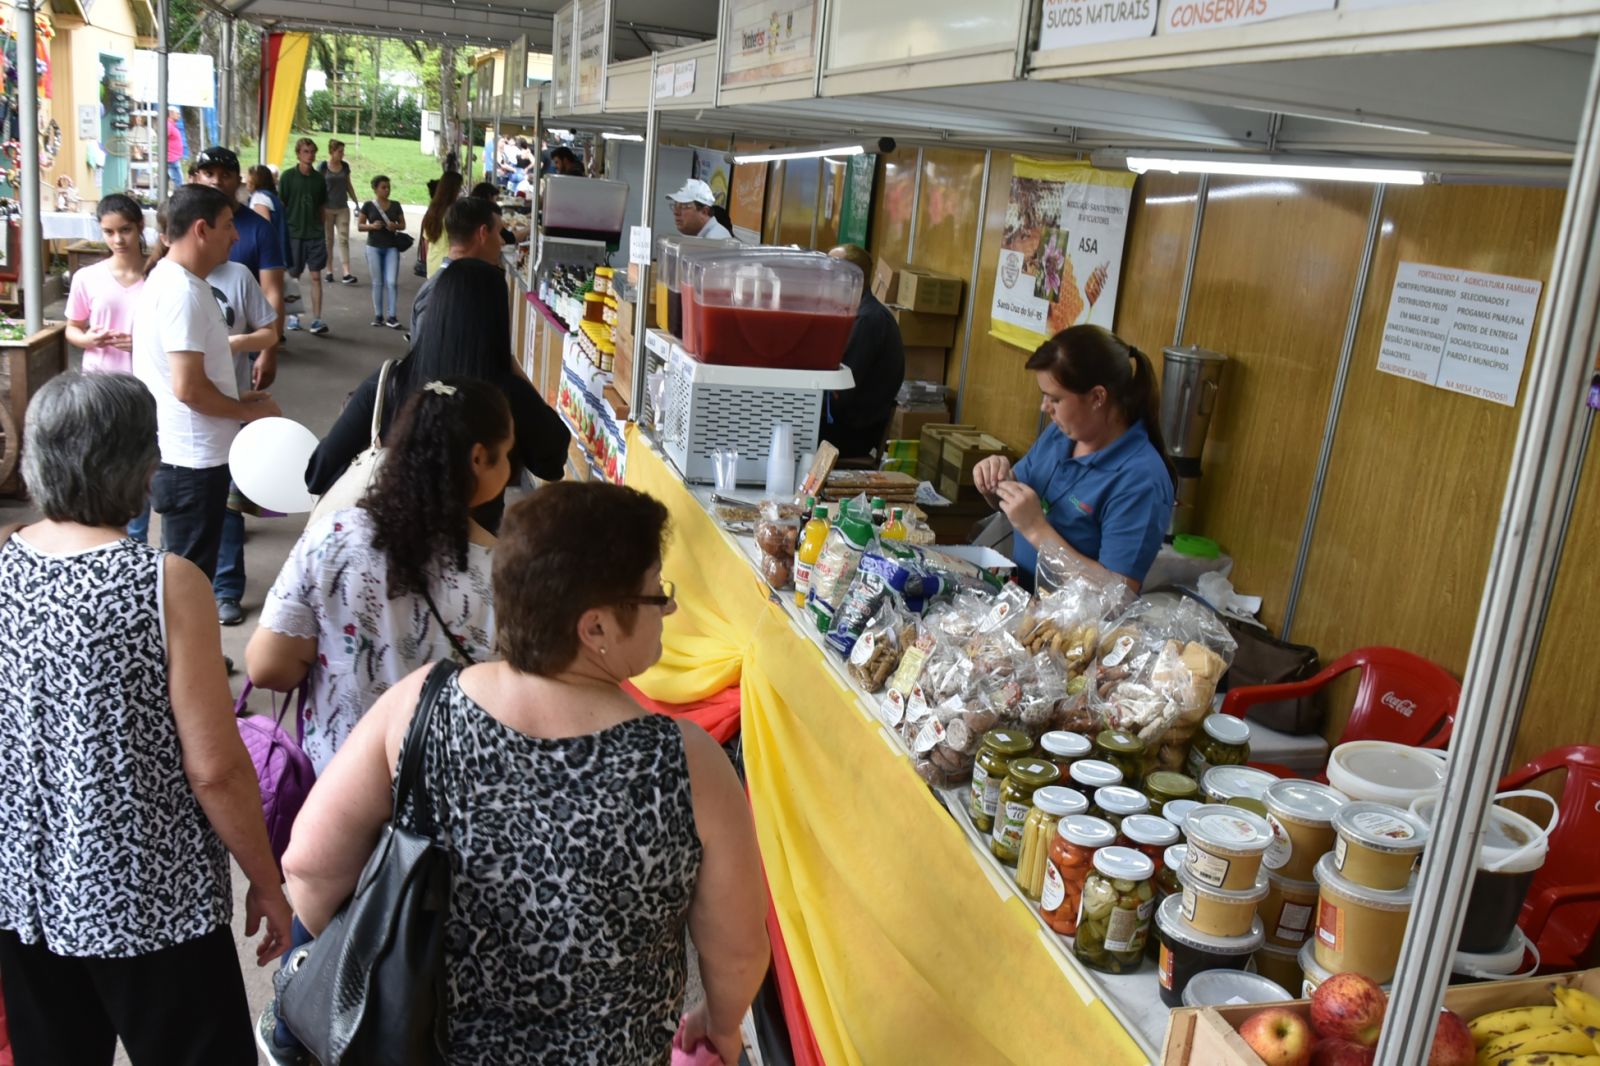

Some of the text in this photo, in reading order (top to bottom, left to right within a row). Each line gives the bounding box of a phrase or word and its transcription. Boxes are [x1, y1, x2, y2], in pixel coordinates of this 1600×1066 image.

[1047, 0, 1150, 28] SUCOS NATURAIS
[1171, 0, 1267, 27] CONSERVAS
[1079, 237, 1098, 254] ASA
[1463, 277, 1505, 289] AGRICULTURA
[997, 299, 1009, 310] Santa
[1459, 291, 1504, 306] SELECIONADOS
[1431, 302, 1448, 312] PELOS
[1408, 312, 1421, 321] MAIS
[1422, 315, 1429, 323] DE
[1453, 321, 1478, 333] PONTOS
[1479, 326, 1488, 335] DE
[1488, 328, 1518, 341] ENTREGA
[1410, 340, 1423, 349] VALE
[1423, 343, 1432, 351] DO
[1446, 350, 1467, 361] PARDO
[1499, 347, 1509, 355] DA
